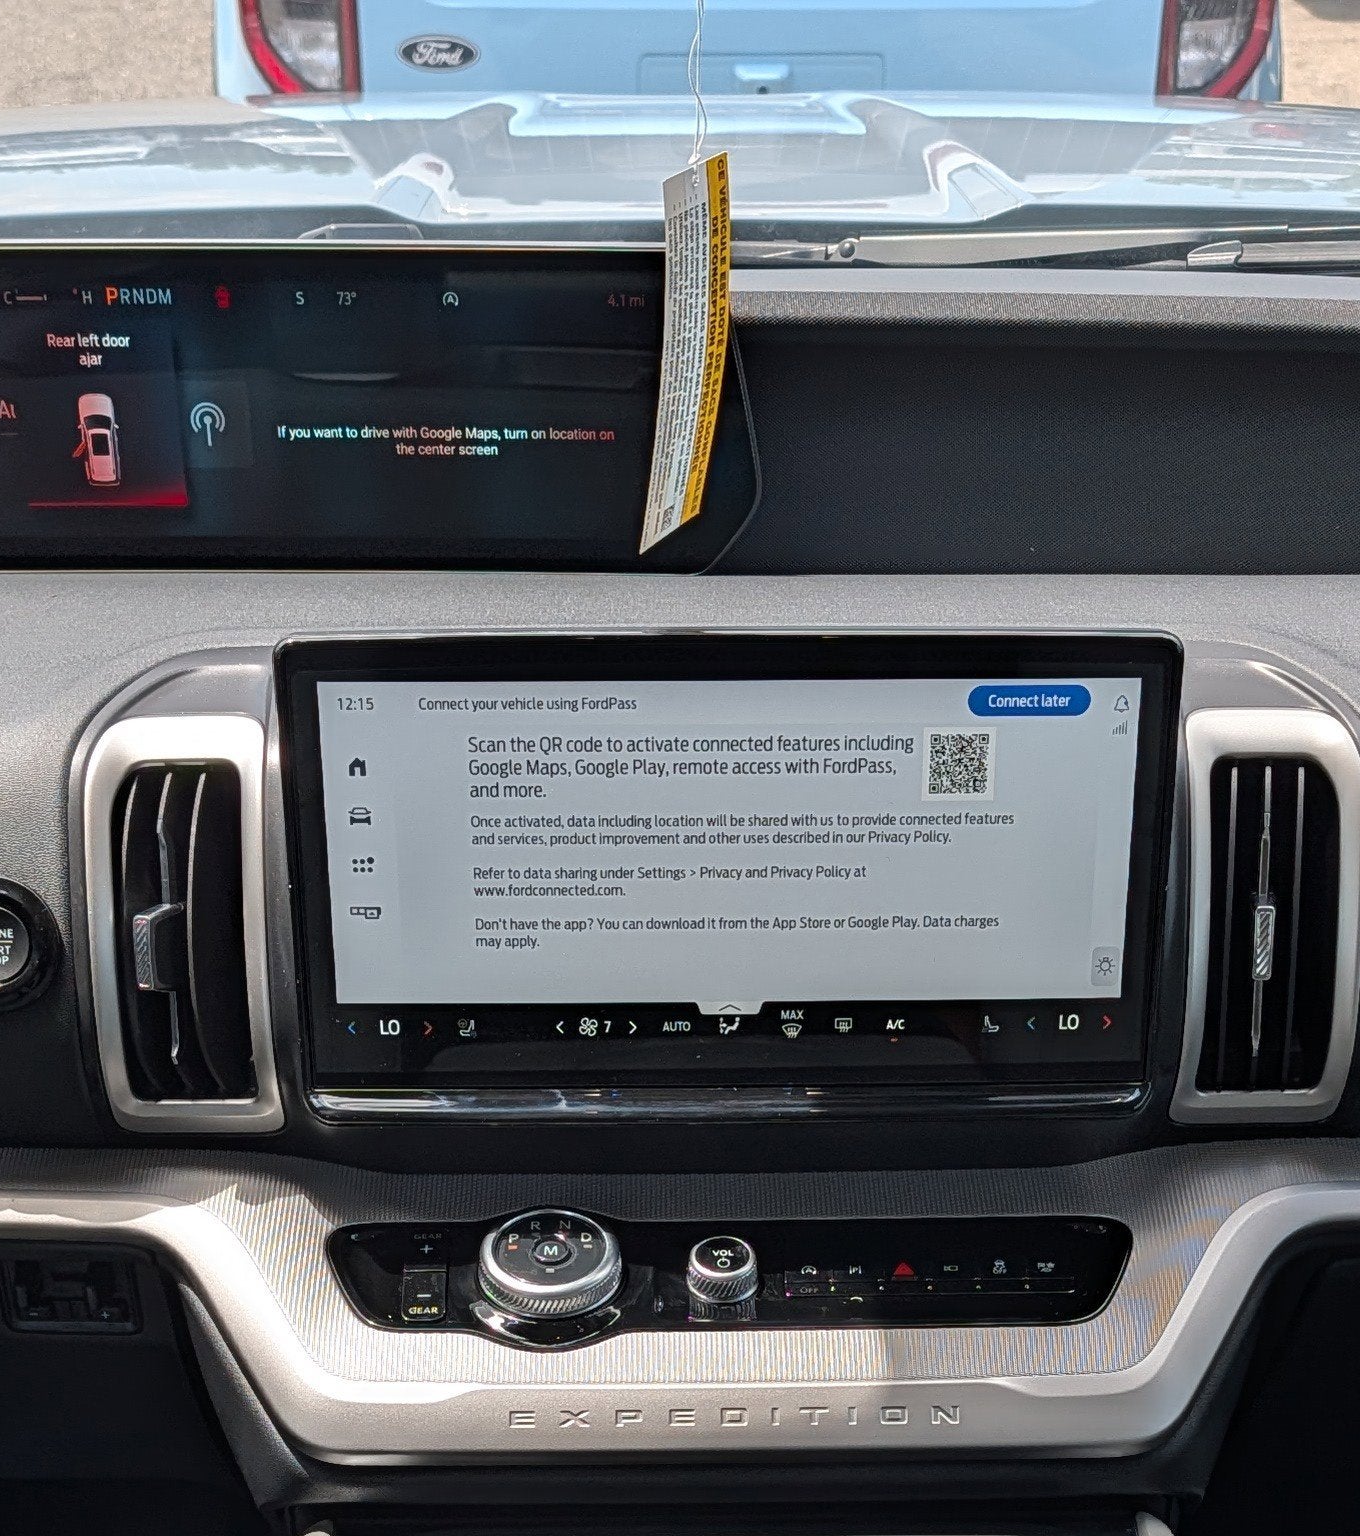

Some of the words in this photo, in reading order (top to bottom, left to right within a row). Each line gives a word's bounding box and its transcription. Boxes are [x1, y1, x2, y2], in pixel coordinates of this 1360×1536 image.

[411, 42, 463, 65] Ford
[82, 290, 93, 305] H
[296, 291, 305, 305] S
[47, 334, 76, 347] Rear
[77, 333, 100, 347] left
[102, 333, 130, 347] door
[79, 352, 103, 367] ajar
[277, 426, 286, 438] If
[289, 428, 311, 441] you
[313, 426, 342, 438] want
[346, 427, 358, 438] to
[360, 426, 389, 438] drive
[392, 426, 417, 439] with
[420, 427, 462, 441] Google
[465, 427, 501, 442] Maps,
[504, 428, 528, 439] turn
[531, 430, 546, 440] on
[549, 427, 596, 440] location
[599, 430, 615, 440] on
[396, 443, 415, 455] the
[418, 444, 456, 456] center
[459, 445, 498, 456] screen
[337, 697, 374, 711] 12:15
[418, 697, 469, 710] Connect
[471, 700, 499, 713] your
[500, 697, 543, 710] vehicle
[546, 697, 578, 712] using
[581, 697, 637, 710] FordPass
[988, 694, 1039, 708] Connect
[1041, 694, 1071, 707] later
[467, 736, 506, 753] Scan
[508, 736, 536, 753] the
[539, 736, 562, 756] QR
[565, 736, 602, 752] code
[605, 736, 623, 752] to
[626, 736, 689, 752] activate
[692, 735, 773, 752] connected
[776, 735, 840, 751] features
[844, 735, 914, 754] including
[468, 759, 522, 778] Google
[525, 759, 571, 778] Maps,
[574, 759, 628, 778] Google
[632, 759, 669, 778] Play,
[672, 758, 728, 774] remote
[731, 762, 781, 774] access
[784, 758, 819, 774] with
[823, 758, 896, 777] FordPass,
[469, 781, 499, 798] and
[503, 785, 546, 798] more.
[470, 815, 501, 828] Once
[503, 815, 564, 831] activated,
[566, 814, 596, 827] data
[597, 814, 652, 830] including
[654, 814, 703, 827] location
[705, 814, 727, 827] will
[730, 814, 745, 827] be
[747, 813, 788, 826] shared
[790, 813, 817, 826] with
[819, 816, 833, 826] us
[836, 813, 849, 826] to
[851, 813, 896, 829] provide
[899, 812, 962, 825] connected
[964, 812, 1014, 825] features
[471, 832, 495, 845] and
[497, 832, 547, 848] services,
[549, 832, 596, 848] product
[598, 832, 680, 847] improvement
[682, 831, 706, 844] and
[708, 831, 741, 844] other
[742, 834, 770, 844] uses
[772, 831, 830, 844] described
[832, 831, 843, 843] in
[845, 833, 866, 843] our
[868, 830, 911, 846] Privacy
[913, 830, 951, 846] Policy.
[472, 867, 505, 880] Refer
[507, 867, 520, 880] to
[522, 867, 551, 880] data
[554, 866, 597, 882] sharing
[599, 866, 634, 879] under
[636, 866, 686, 882] Settings
[689, 869, 696, 879] >
[699, 866, 742, 882] Privacy
[744, 866, 768, 879] and
[770, 865, 813, 881] Privacy
[815, 865, 851, 881] Policy
[853, 865, 867, 878] at
[473, 884, 626, 897] www.fordconnected.com.
[474, 918, 507, 930] Don't
[509, 918, 538, 930] have
[540, 917, 561, 930] the
[563, 917, 593, 933] app?
[596, 917, 619, 930] You
[622, 920, 642, 929] can
[645, 917, 705, 929] download
[706, 917, 716, 929] it
[718, 916, 747, 929] from
[749, 916, 769, 929] the
[771, 916, 796, 932] App
[798, 916, 831, 928] Store
[833, 919, 846, 928] or
[847, 916, 889, 931] Google
[891, 916, 919, 931] Play.
[922, 915, 951, 928] Data
[953, 915, 999, 931] charges
[474, 937, 502, 950] may
[504, 934, 539, 949] apply.
[781, 1010, 804, 1020] MAX
[1058, 1014, 1080, 1030] LO
[379, 1019, 401, 1036] LO
[604, 1020, 612, 1034] 7
[662, 1021, 691, 1032] AUTO
[886, 1018, 906, 1030] A/C
[530, 1220, 540, 1231] R
[559, 1219, 572, 1230] N
[508, 1233, 520, 1243] P
[580, 1233, 592, 1243] D
[544, 1245, 558, 1256] M
[712, 1249, 734, 1257] VOL
[799, 1286, 819, 1294] OFF
[408, 1306, 439, 1315] GEAR
[508, 1404, 961, 1429] EXPEDITION
